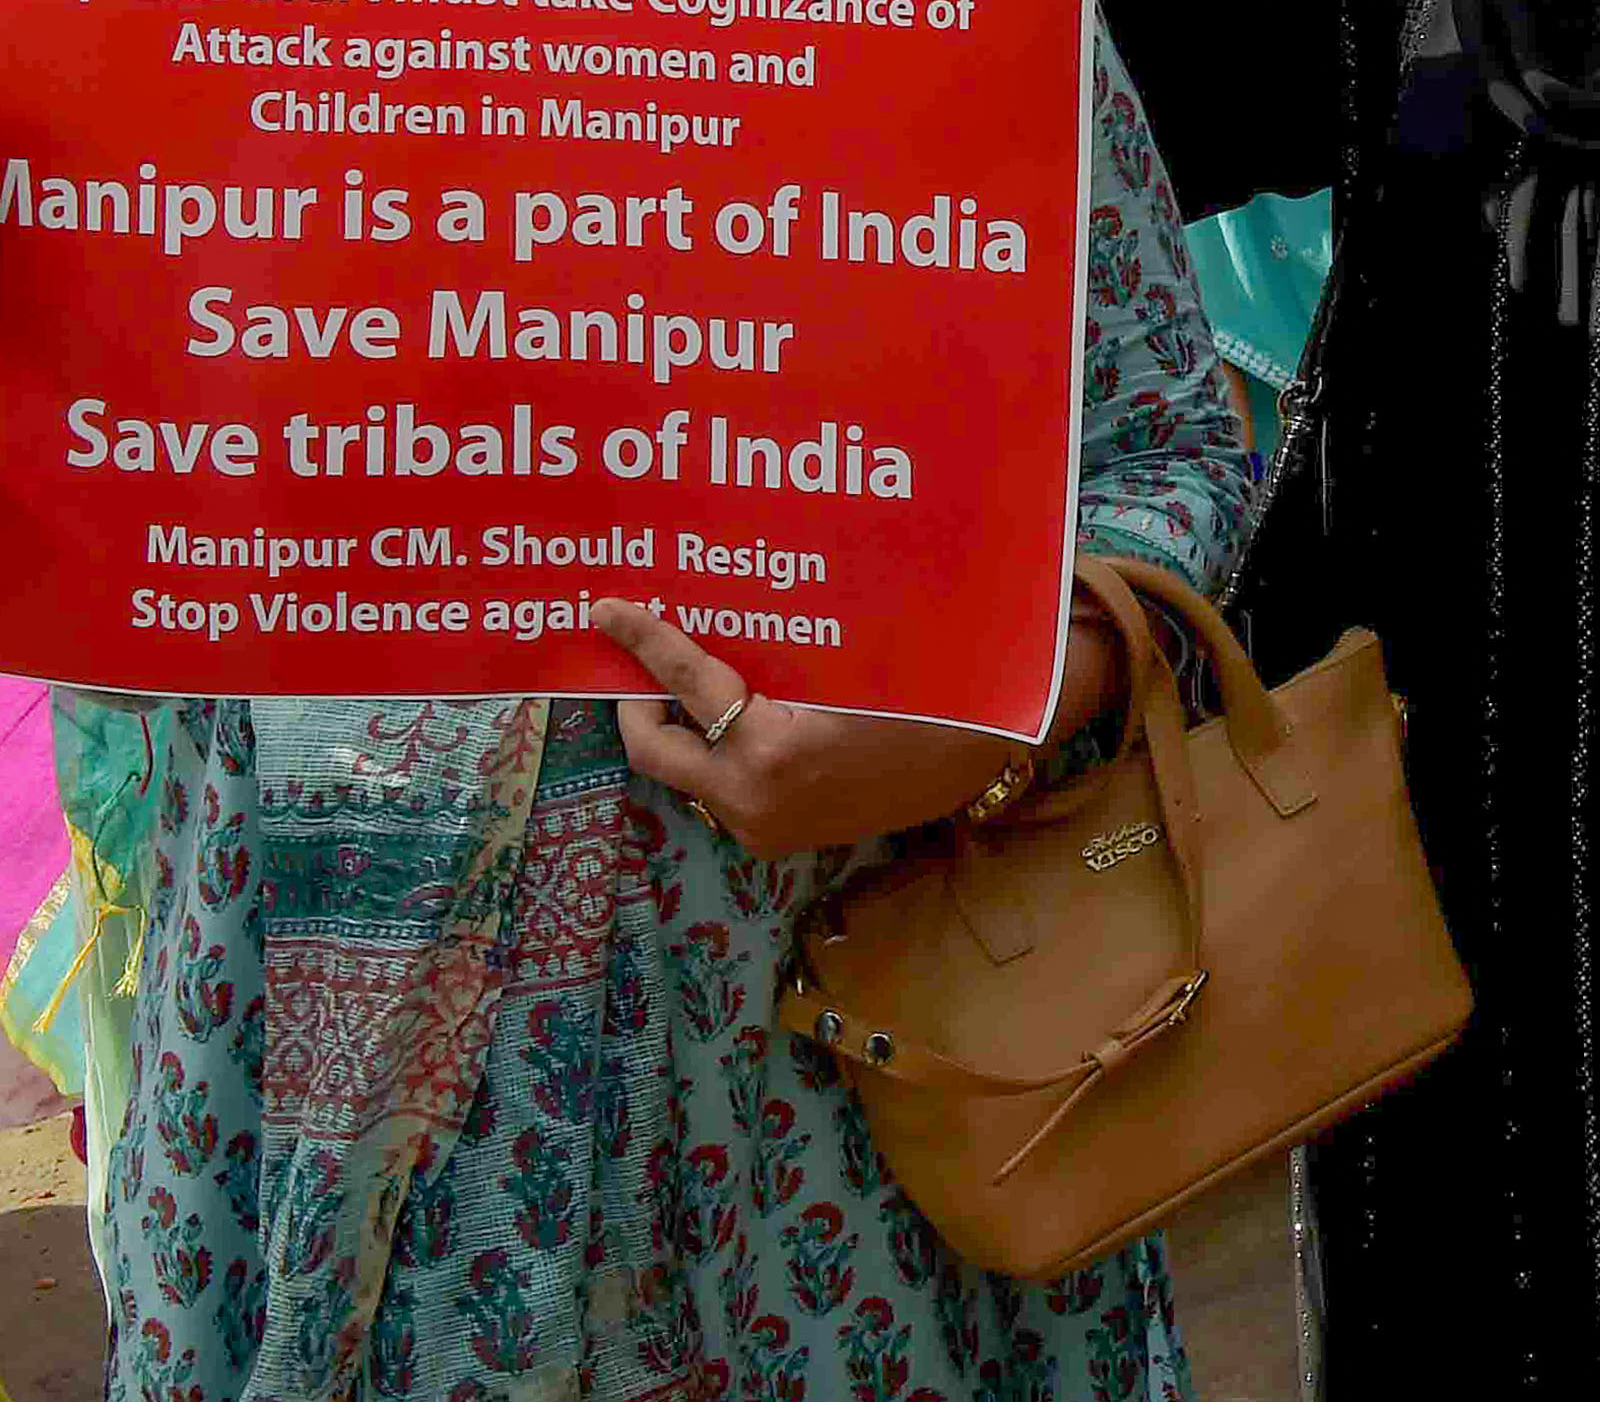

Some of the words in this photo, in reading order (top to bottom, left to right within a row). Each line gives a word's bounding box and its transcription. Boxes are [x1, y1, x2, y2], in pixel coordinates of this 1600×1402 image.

[172, 23, 332, 66] Attack
[344, 29, 530, 78] against
[543, 44, 715, 80] women
[730, 46, 814, 86] and
[251, 91, 464, 134] Children
[482, 95, 524, 135] in
[541, 99, 740, 153] Manipur
[344, 169, 410, 240] is
[437, 190, 484, 241] a
[515, 188, 692, 261] part
[716, 185, 800, 256] of
[823, 192, 1025, 272] India
[188, 287, 400, 358] Save
[429, 291, 793, 383] Manipur
[67, 399, 258, 475] Save
[283, 404, 577, 476] tribals
[603, 410, 689, 480] of
[711, 417, 911, 498] India
[148, 525, 357, 577] Manipur
[371, 528, 467, 566] CM.
[482, 525, 653, 567] Should
[678, 533, 825, 589] Resign
[132, 589, 238, 641] Stop
[250, 592, 469, 632] Violence
[483, 589, 666, 642] agait
[676, 604, 842, 648] women
